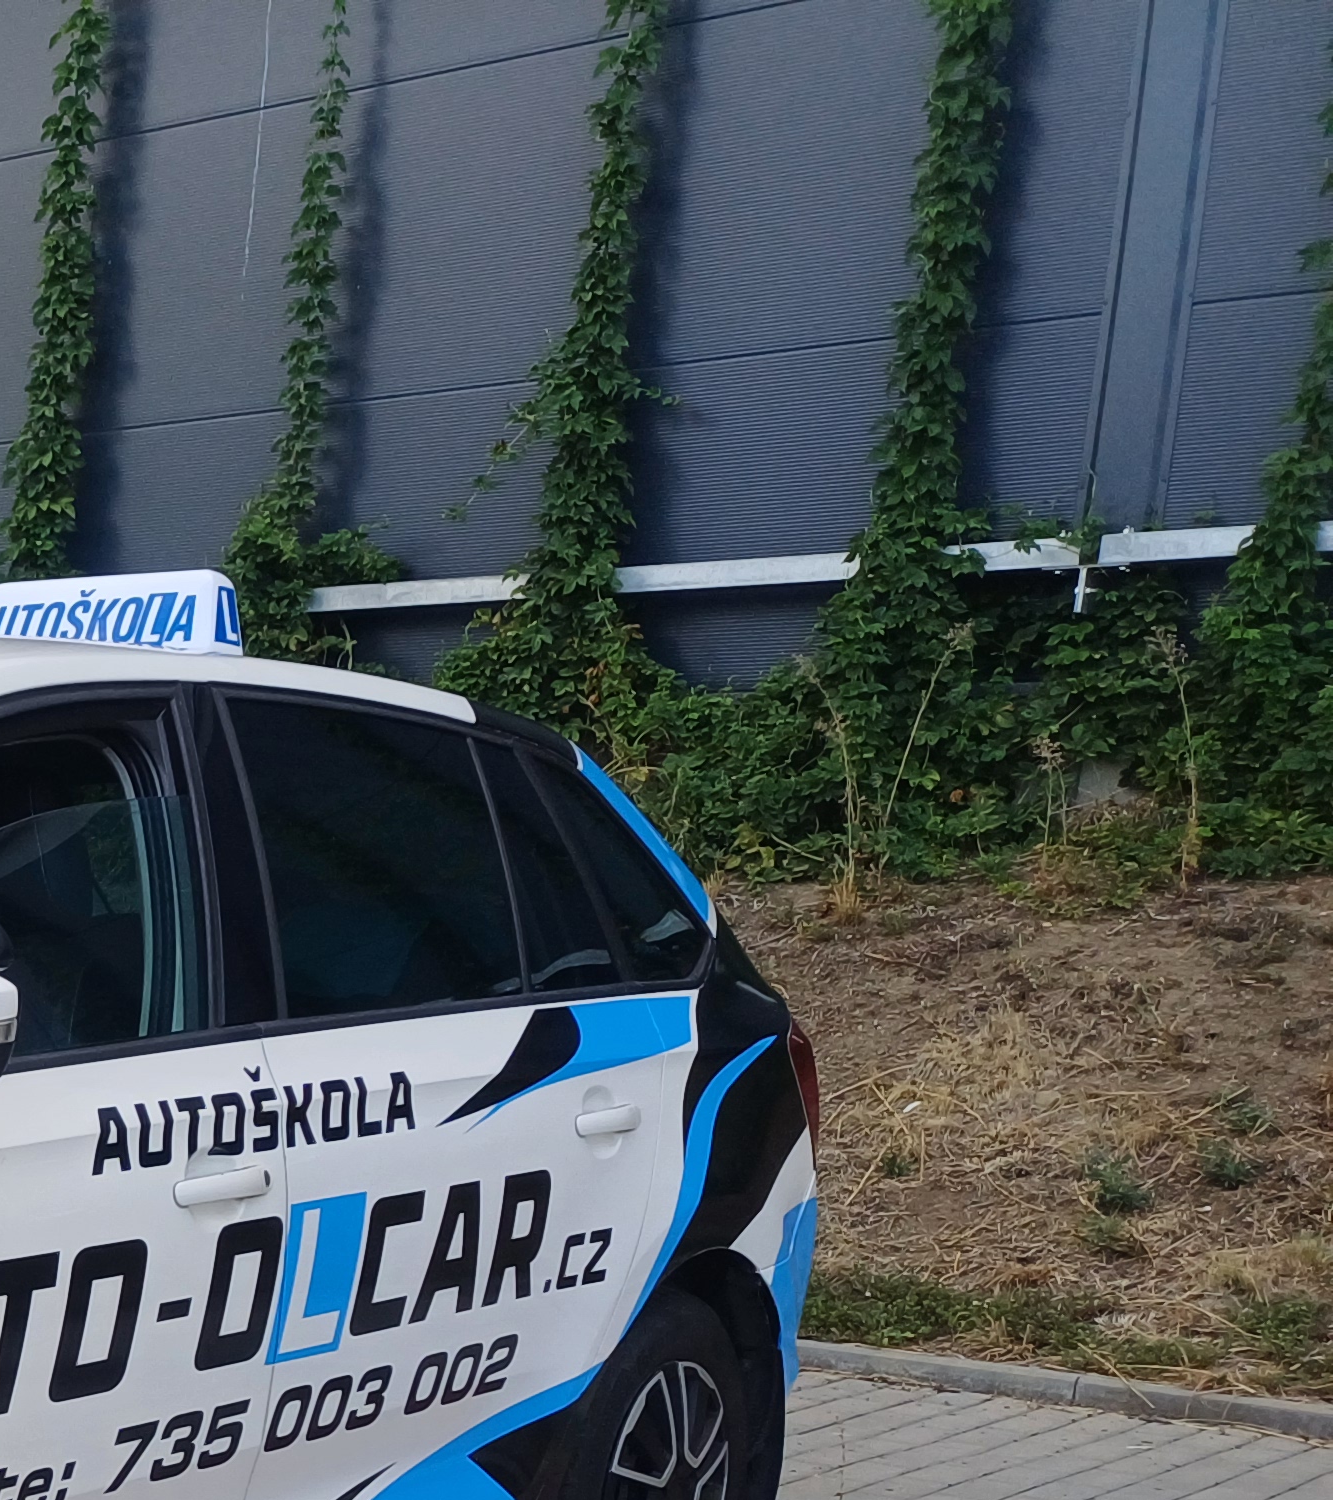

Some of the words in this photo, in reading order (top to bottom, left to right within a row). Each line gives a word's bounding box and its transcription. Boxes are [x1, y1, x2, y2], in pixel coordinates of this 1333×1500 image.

[91, 1066, 416, 1176] AUTOŠKOLA
[103, 1400, 250, 1495] 735
[263, 1364, 393, 1452] 003
[402, 1333, 519, 1417] 002
